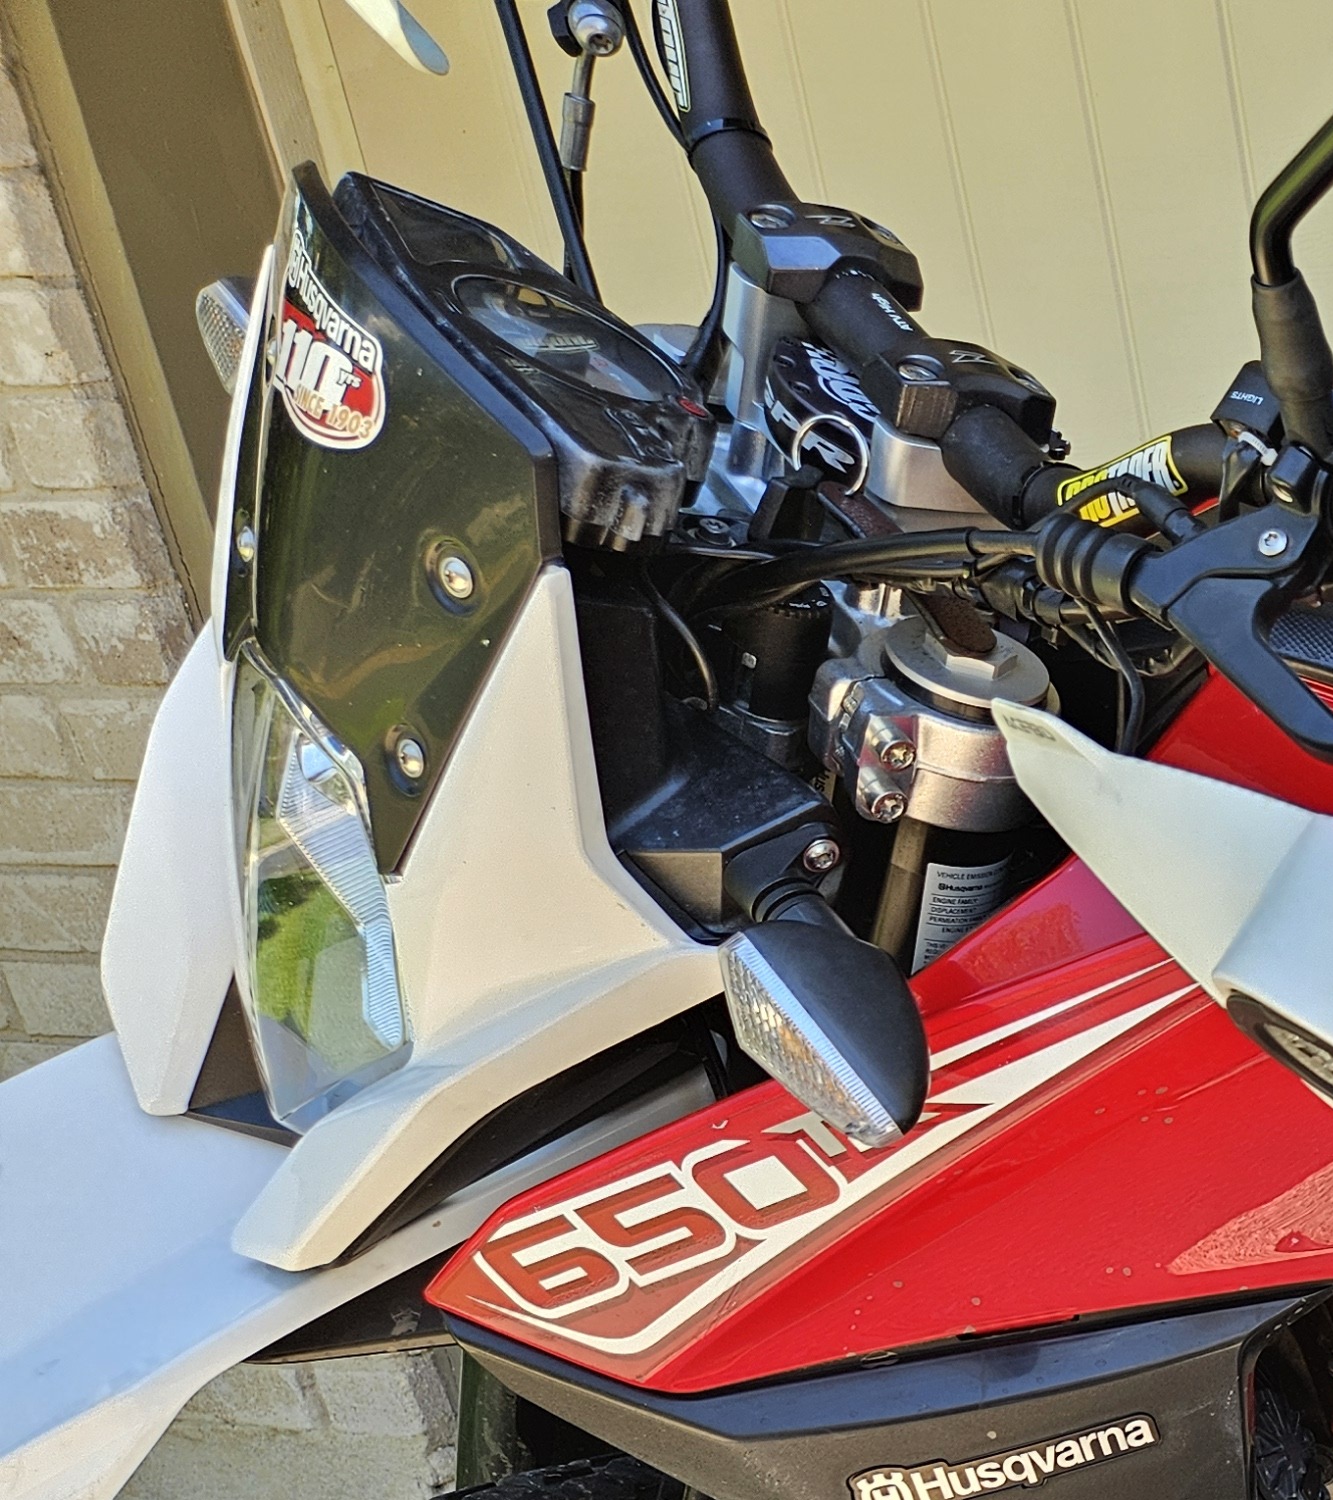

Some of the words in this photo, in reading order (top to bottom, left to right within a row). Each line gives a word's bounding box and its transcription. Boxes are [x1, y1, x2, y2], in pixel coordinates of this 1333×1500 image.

[297, 255, 376, 372] Husqvarna
[294, 383, 326, 420] SINCE
[325, 402, 375, 440] 1903
[1230, 390, 1264, 406] LIGHTS
[478, 1139, 848, 1316] 650
